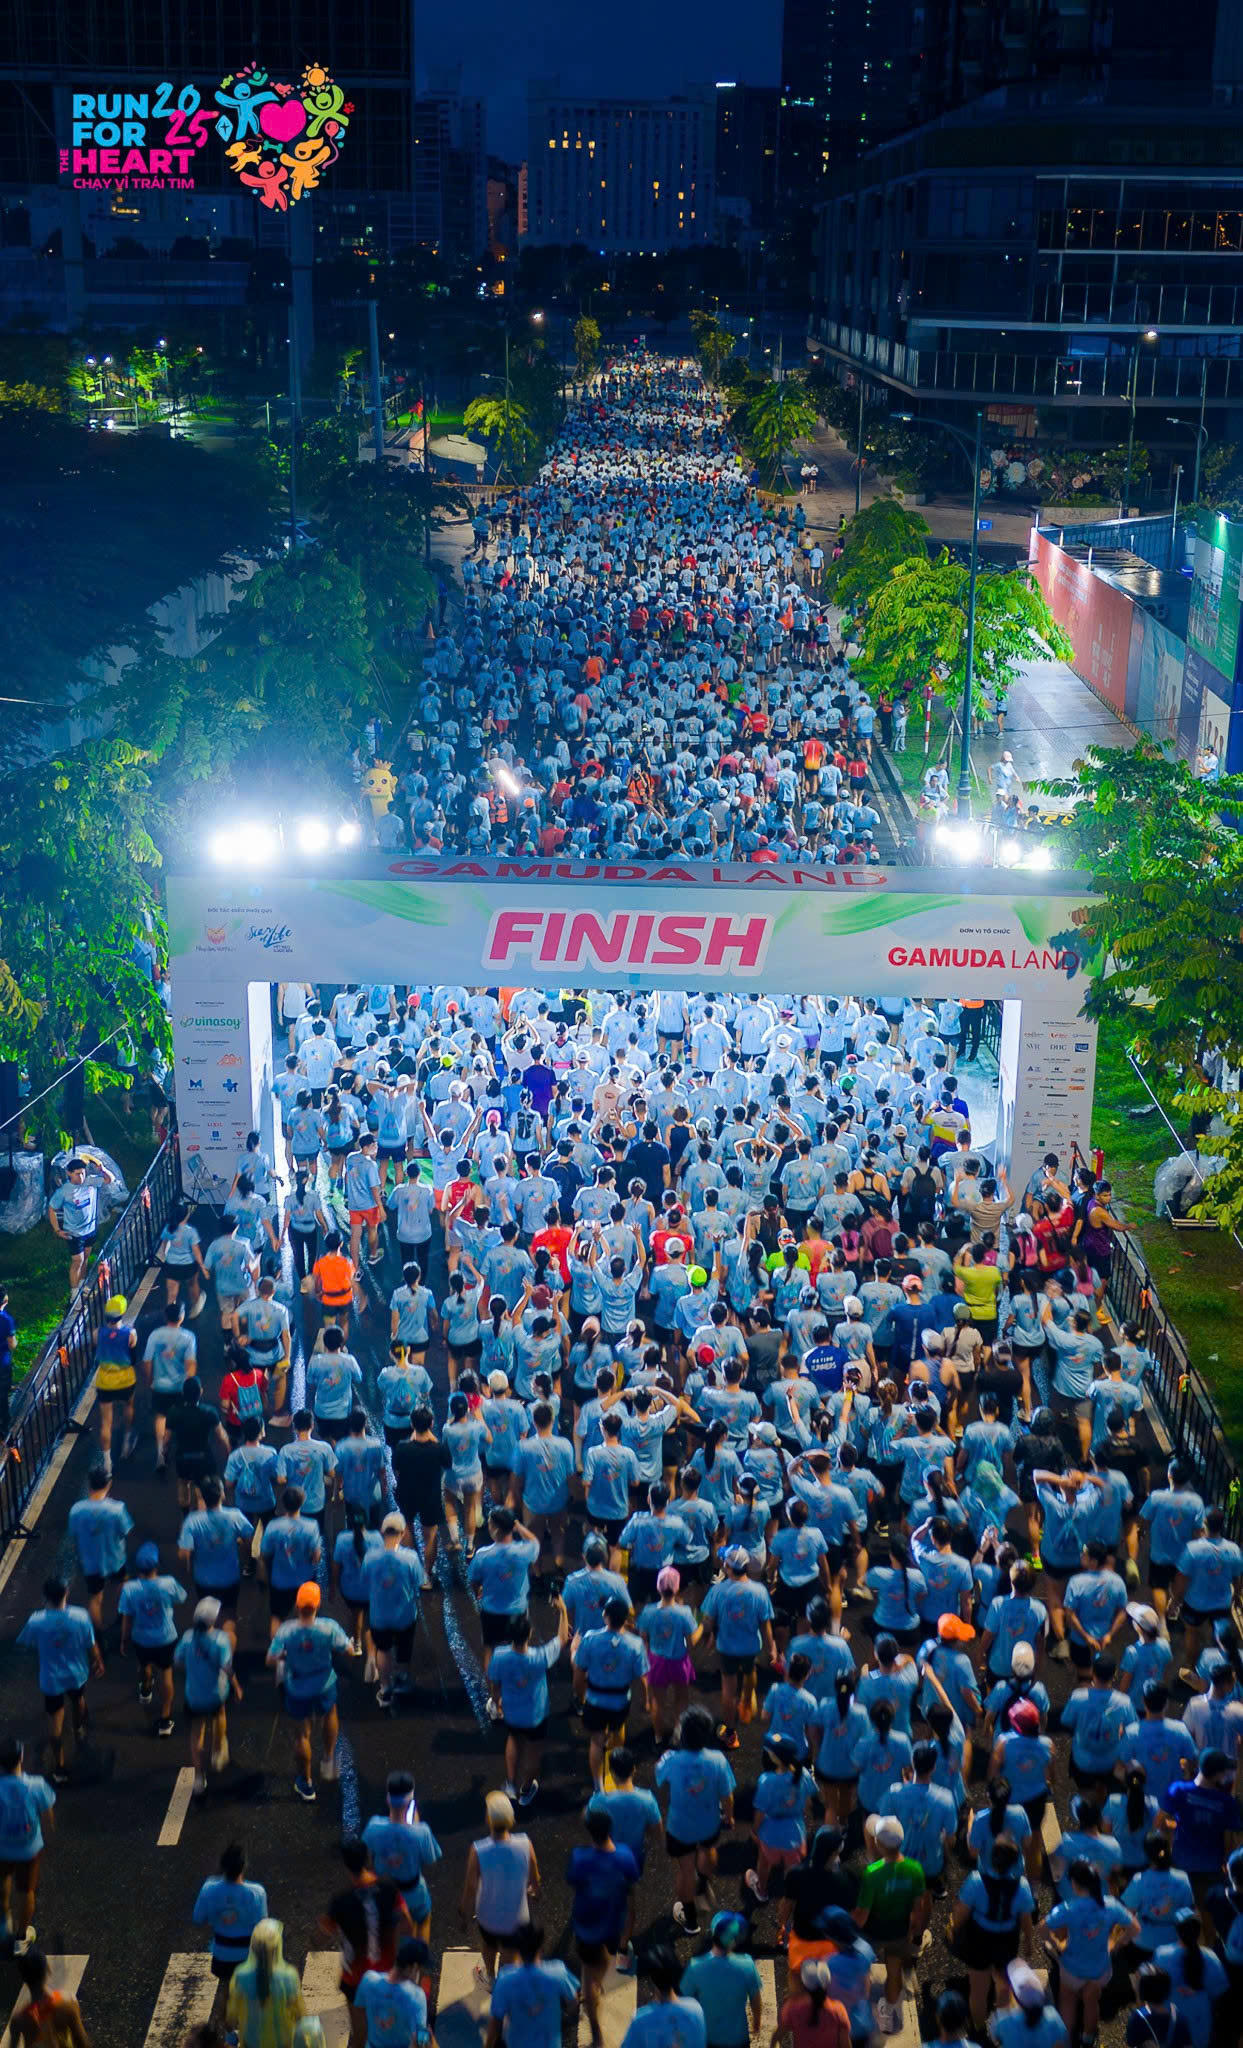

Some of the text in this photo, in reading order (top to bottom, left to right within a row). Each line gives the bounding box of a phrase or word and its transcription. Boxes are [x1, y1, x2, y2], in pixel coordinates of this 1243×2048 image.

[388, 861, 889, 887] GAMUDA LAND
[489, 911, 767, 967] FINISH
[888, 947, 1080, 971] GAMUDA LAND
